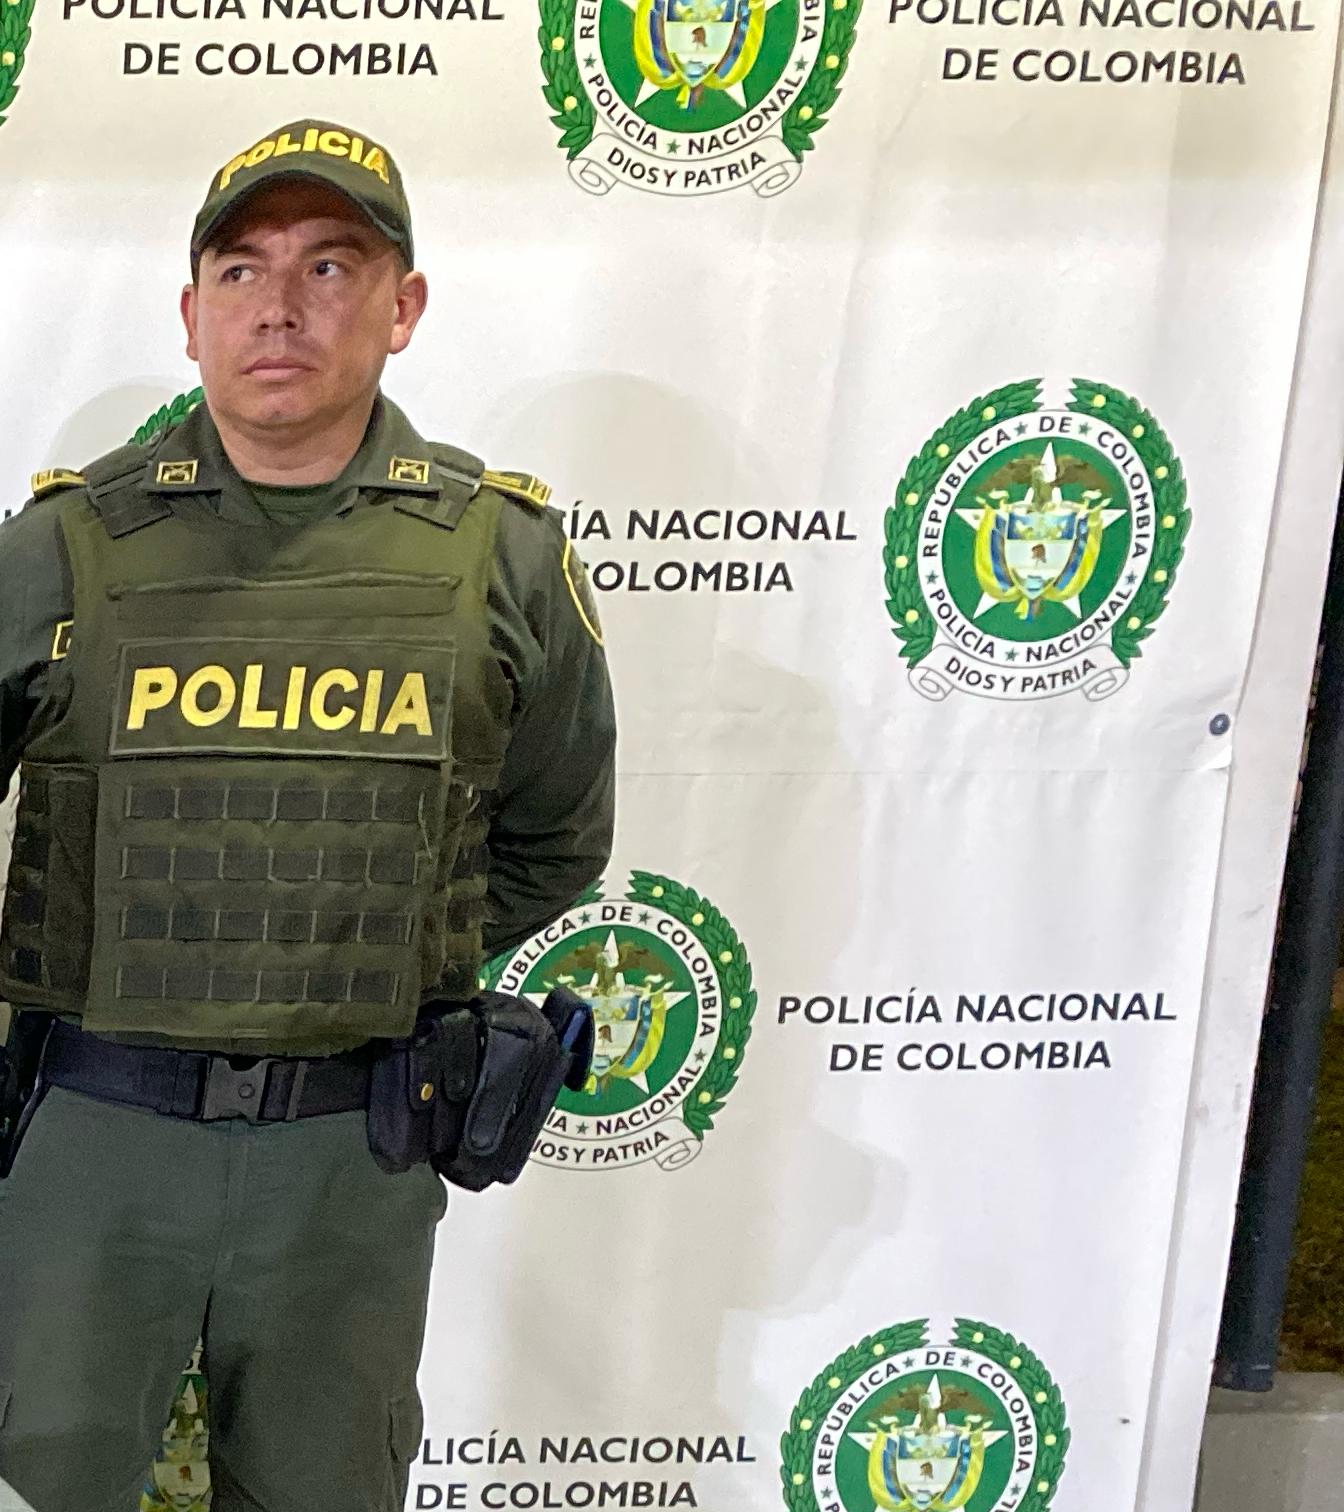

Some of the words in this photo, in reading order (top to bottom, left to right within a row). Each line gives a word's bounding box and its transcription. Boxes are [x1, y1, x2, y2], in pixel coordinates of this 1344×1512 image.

[1079, 0, 1314, 32] NACIONAL
[123, 43, 181, 76] DE
[194, 42, 439, 77] COLOMBIA
[942, 48, 999, 81] DE
[1013, 48, 1247, 85] COLOMBIA
[687, 75, 803, 156] NACIONAL
[219, 128, 390, 191] POLICIA
[683, 151, 767, 188] PATRIA
[1039, 416, 1072, 433] DE
[1097, 430, 1150, 558] COLOMBIA
[626, 509, 858, 541] NACIONAL
[584, 561, 794, 592] OLOMBIA
[1026, 587, 1132, 662] NACIONAL
[1020, 658, 1097, 692] PATRIA
[126, 664, 433, 736] POLICIA
[601, 905, 632, 922] DE
[657, 919, 717, 1037] COLOMBIA
[777, 987, 942, 1025] POLICÍA
[955, 992, 1178, 1023] NACIONAL
[829, 1043, 884, 1072] DE
[896, 1040, 1112, 1071] COLOMBIA
[596, 1065, 702, 1136] NACIONAL
[533, 1138, 569, 1162] IOS
[592, 1131, 670, 1163] PATRIA
[925, 1350, 956, 1366] DE
[977, 1363, 1033, 1473] COLOMBIA
[422, 1429, 525, 1465] LICÍA
[539, 1435, 756, 1464] NACIONAL
[416, 1482, 467, 1510] DE
[480, 1481, 698, 1509] COLOMBIA
